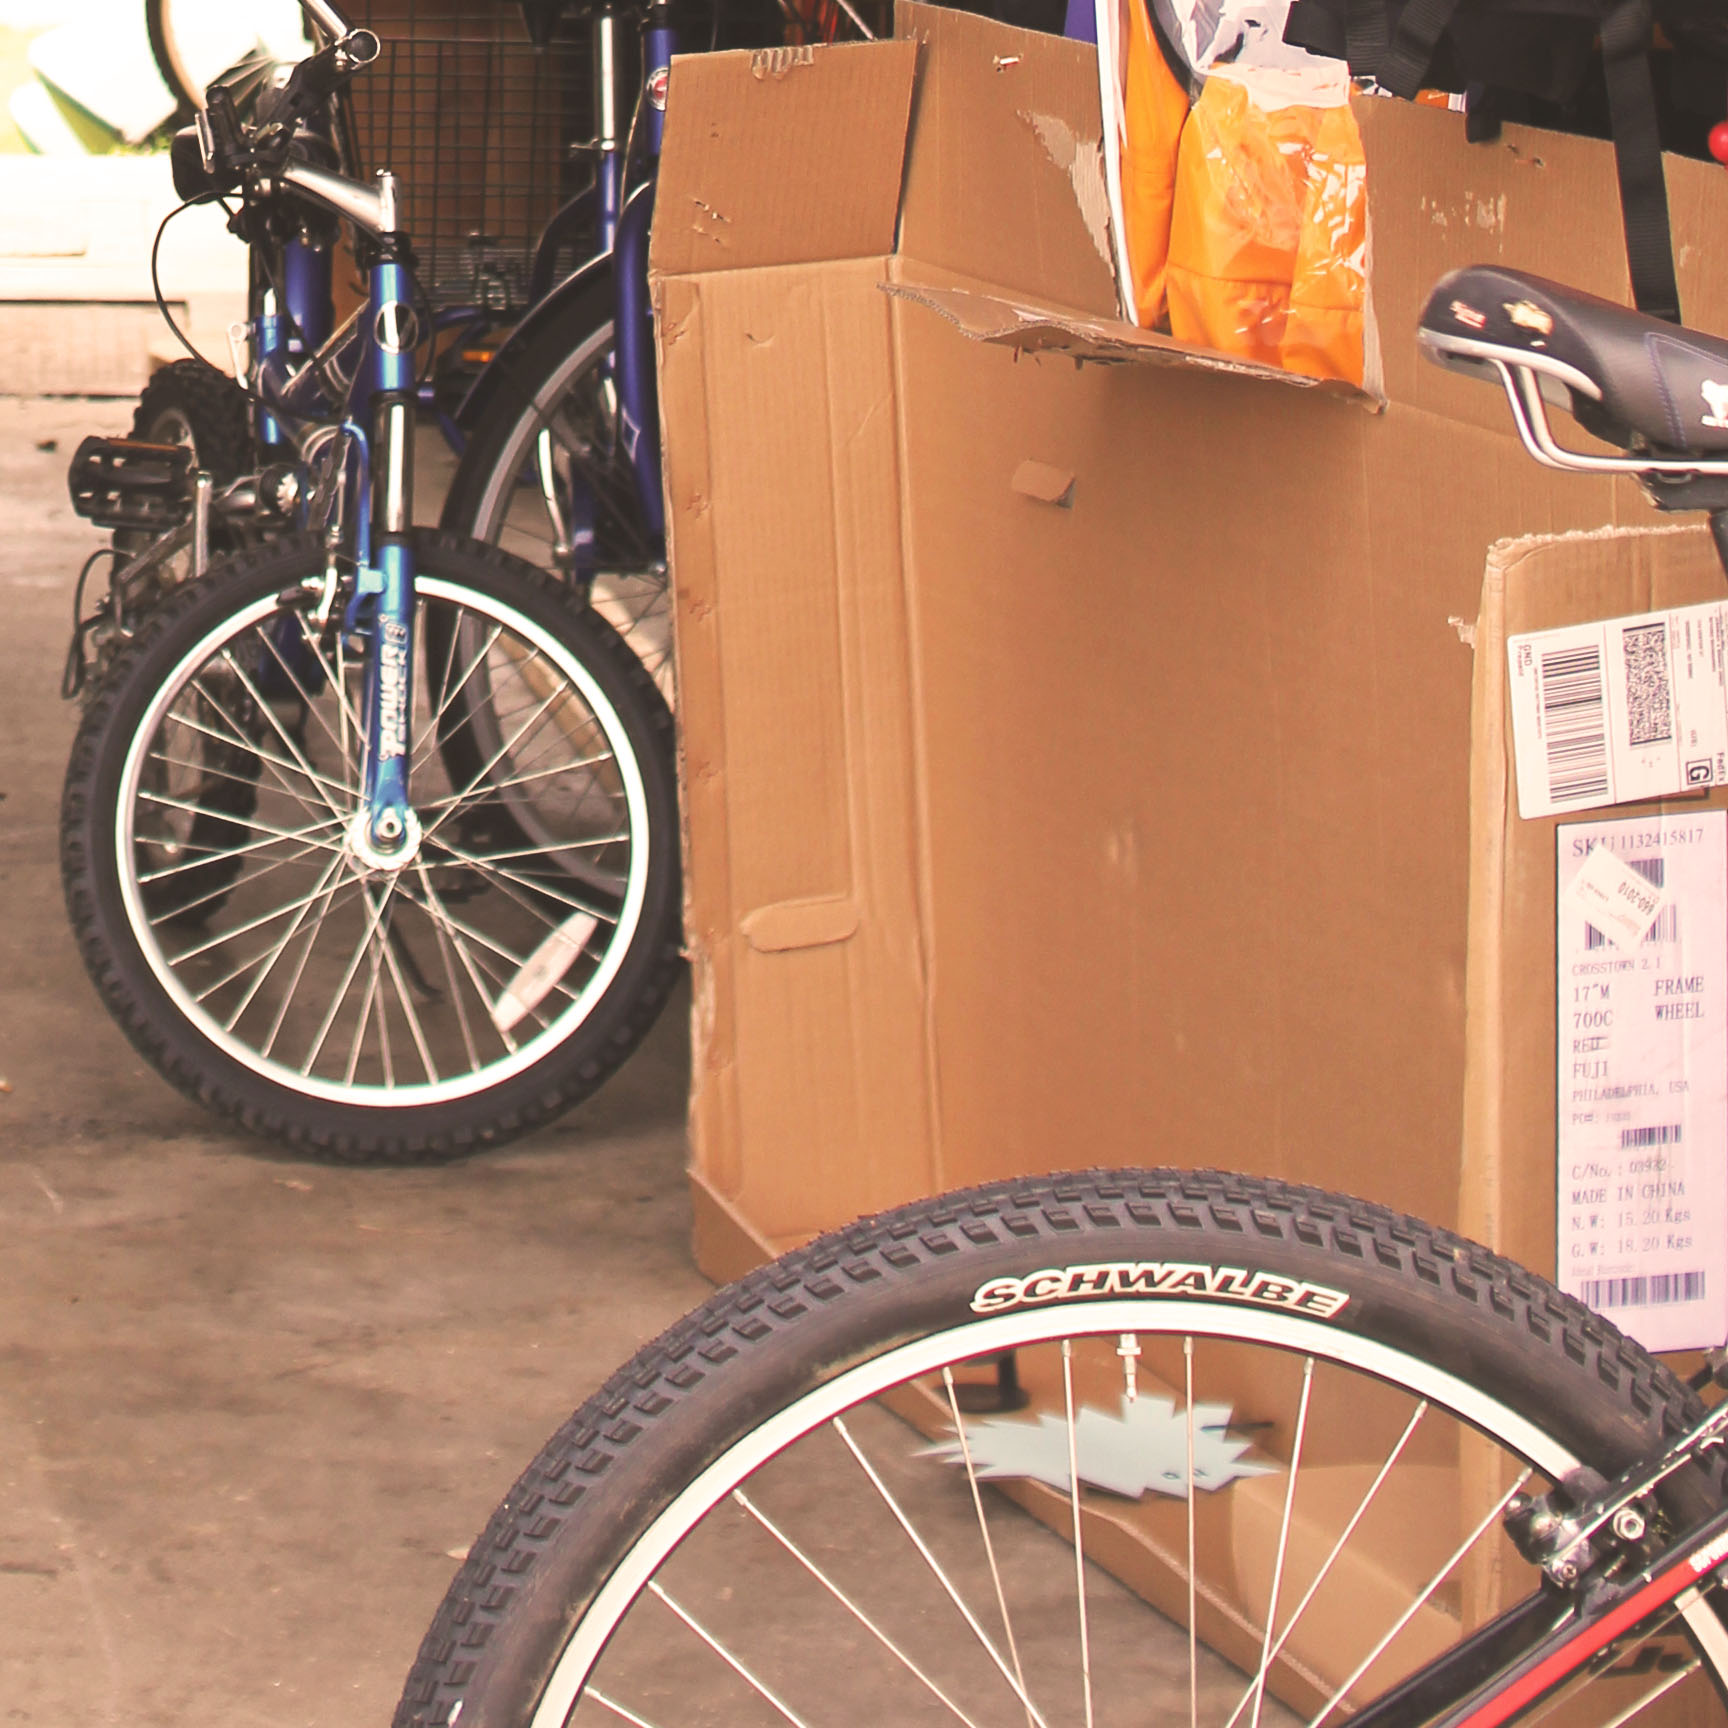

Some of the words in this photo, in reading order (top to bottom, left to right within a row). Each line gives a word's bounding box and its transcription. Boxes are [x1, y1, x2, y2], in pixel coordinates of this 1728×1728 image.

[1688, 764, 1710, 782] G
[1622, 828, 1704, 850] 1132415817
[1654, 976, 1704, 996] FRAME
[1574, 1010, 1613, 1029] 700C
[1655, 1001, 1704, 1021] WHEEL
[1573, 1061, 1608, 1079] FUJI
[1669, 1081, 1689, 1094] USA
[1572, 1189, 1607, 1205] MADE
[1617, 1186, 1633, 1201] IN
[1642, 1182, 1685, 1200] CHINA
[1666, 1207, 1691, 1224] Kgs
[1666, 1234, 1692, 1250] Kgs
[970, 1262, 1351, 1319] SCHWALBE
